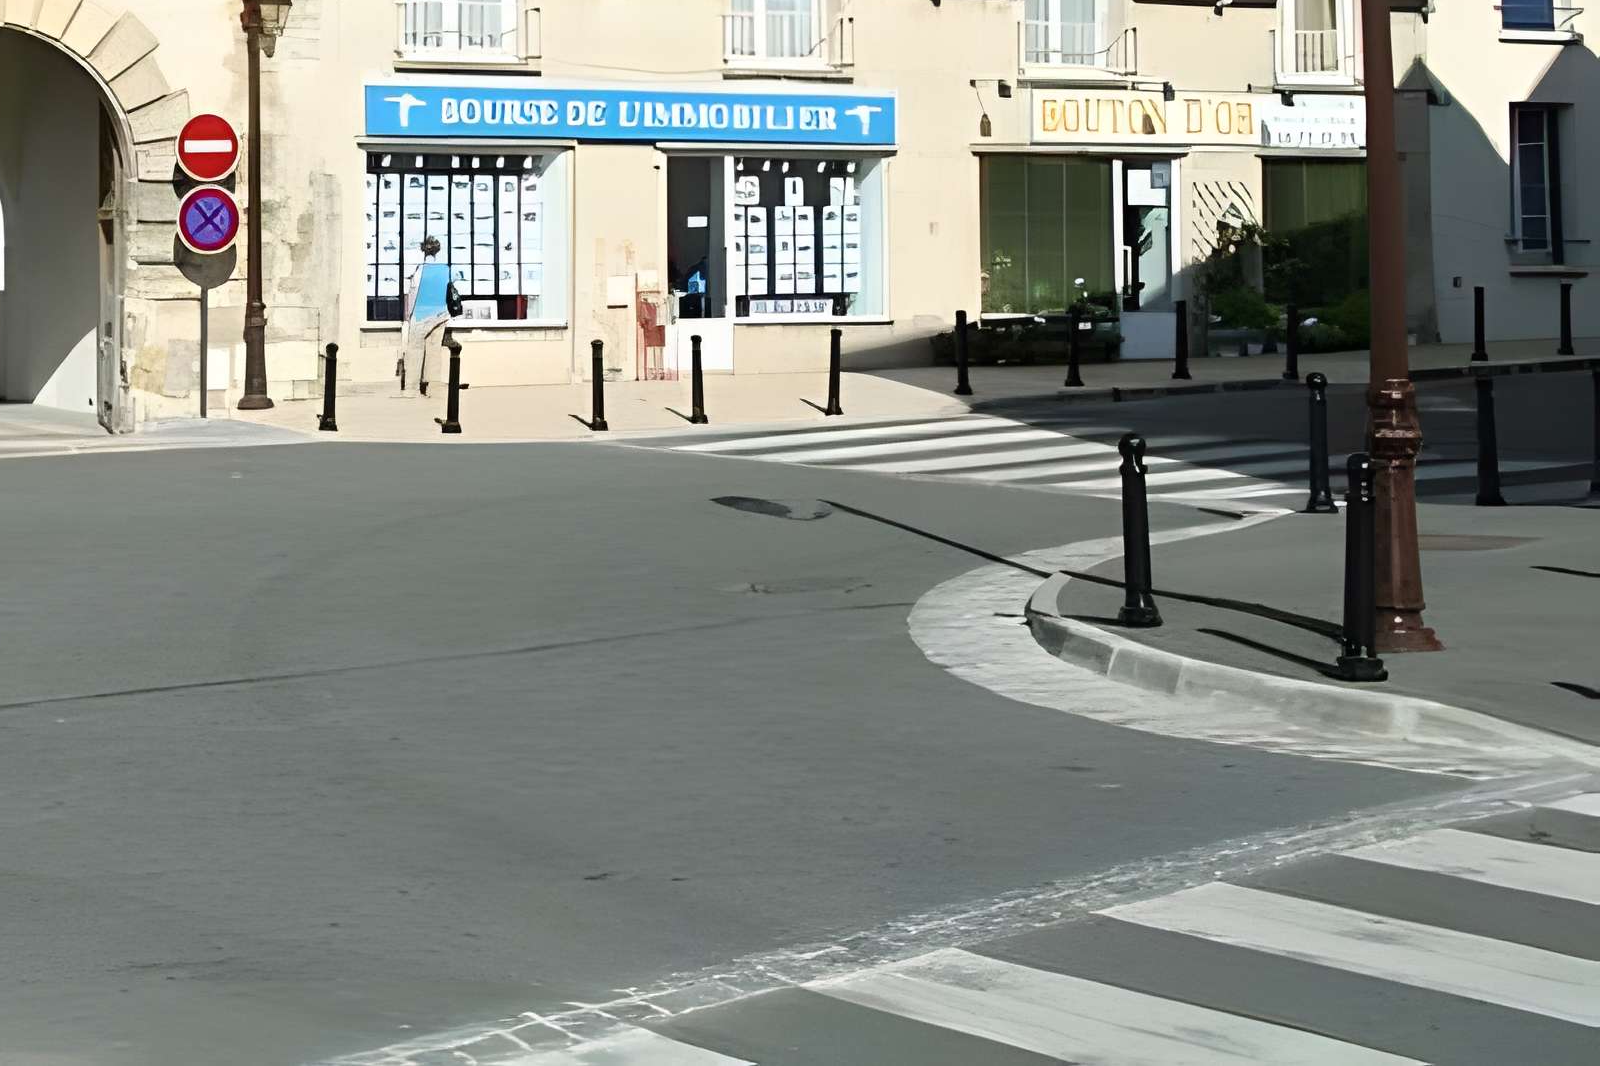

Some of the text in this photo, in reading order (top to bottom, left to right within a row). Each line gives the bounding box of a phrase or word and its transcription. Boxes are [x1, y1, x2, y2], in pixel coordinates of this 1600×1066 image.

[441, 97, 559, 125] BOURSE
[566, 100, 607, 126] DE
[1042, 98, 1167, 134] BOUTON
